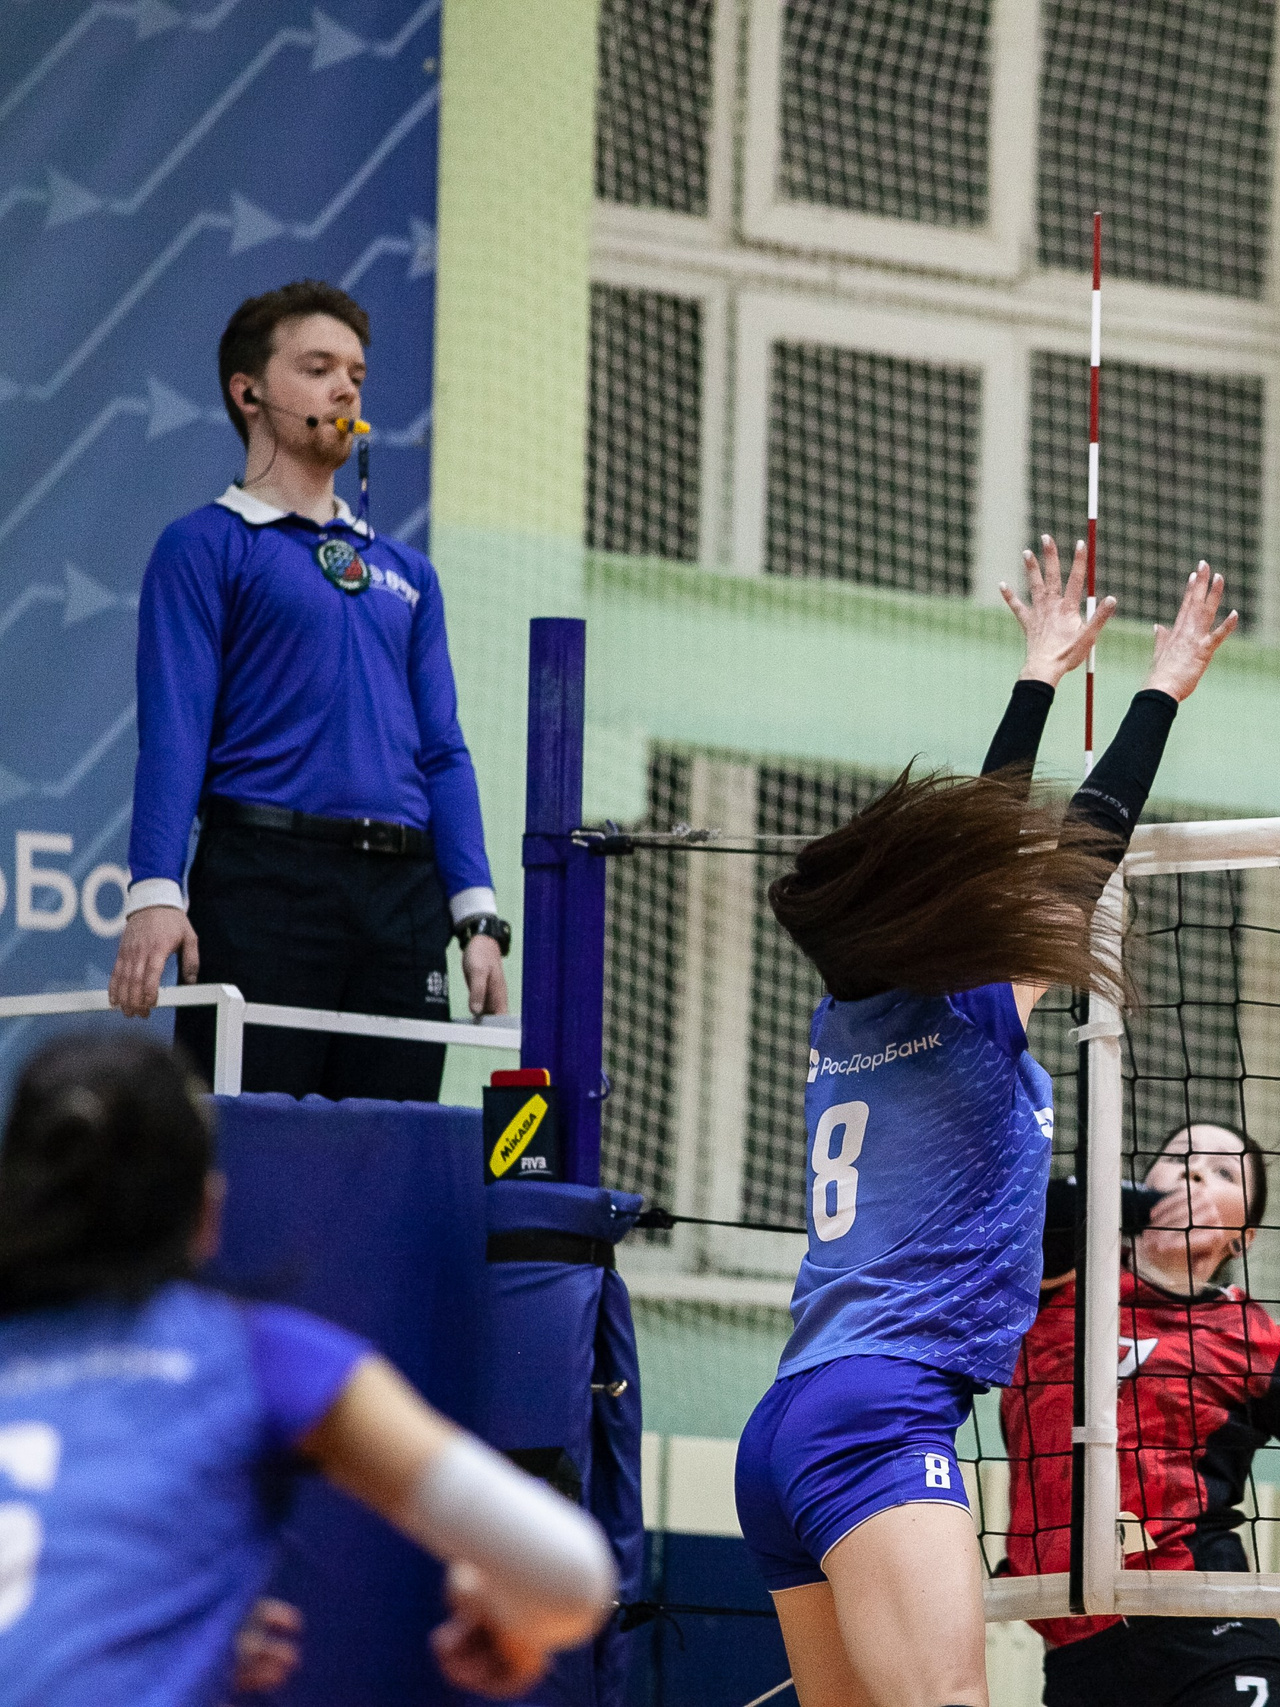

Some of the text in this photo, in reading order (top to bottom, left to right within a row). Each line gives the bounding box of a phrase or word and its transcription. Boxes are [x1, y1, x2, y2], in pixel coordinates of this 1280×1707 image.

[820, 1033, 943, 1076] РосДорБанк
[812, 1101, 869, 1242] 8
[925, 1453, 951, 1489] 8
